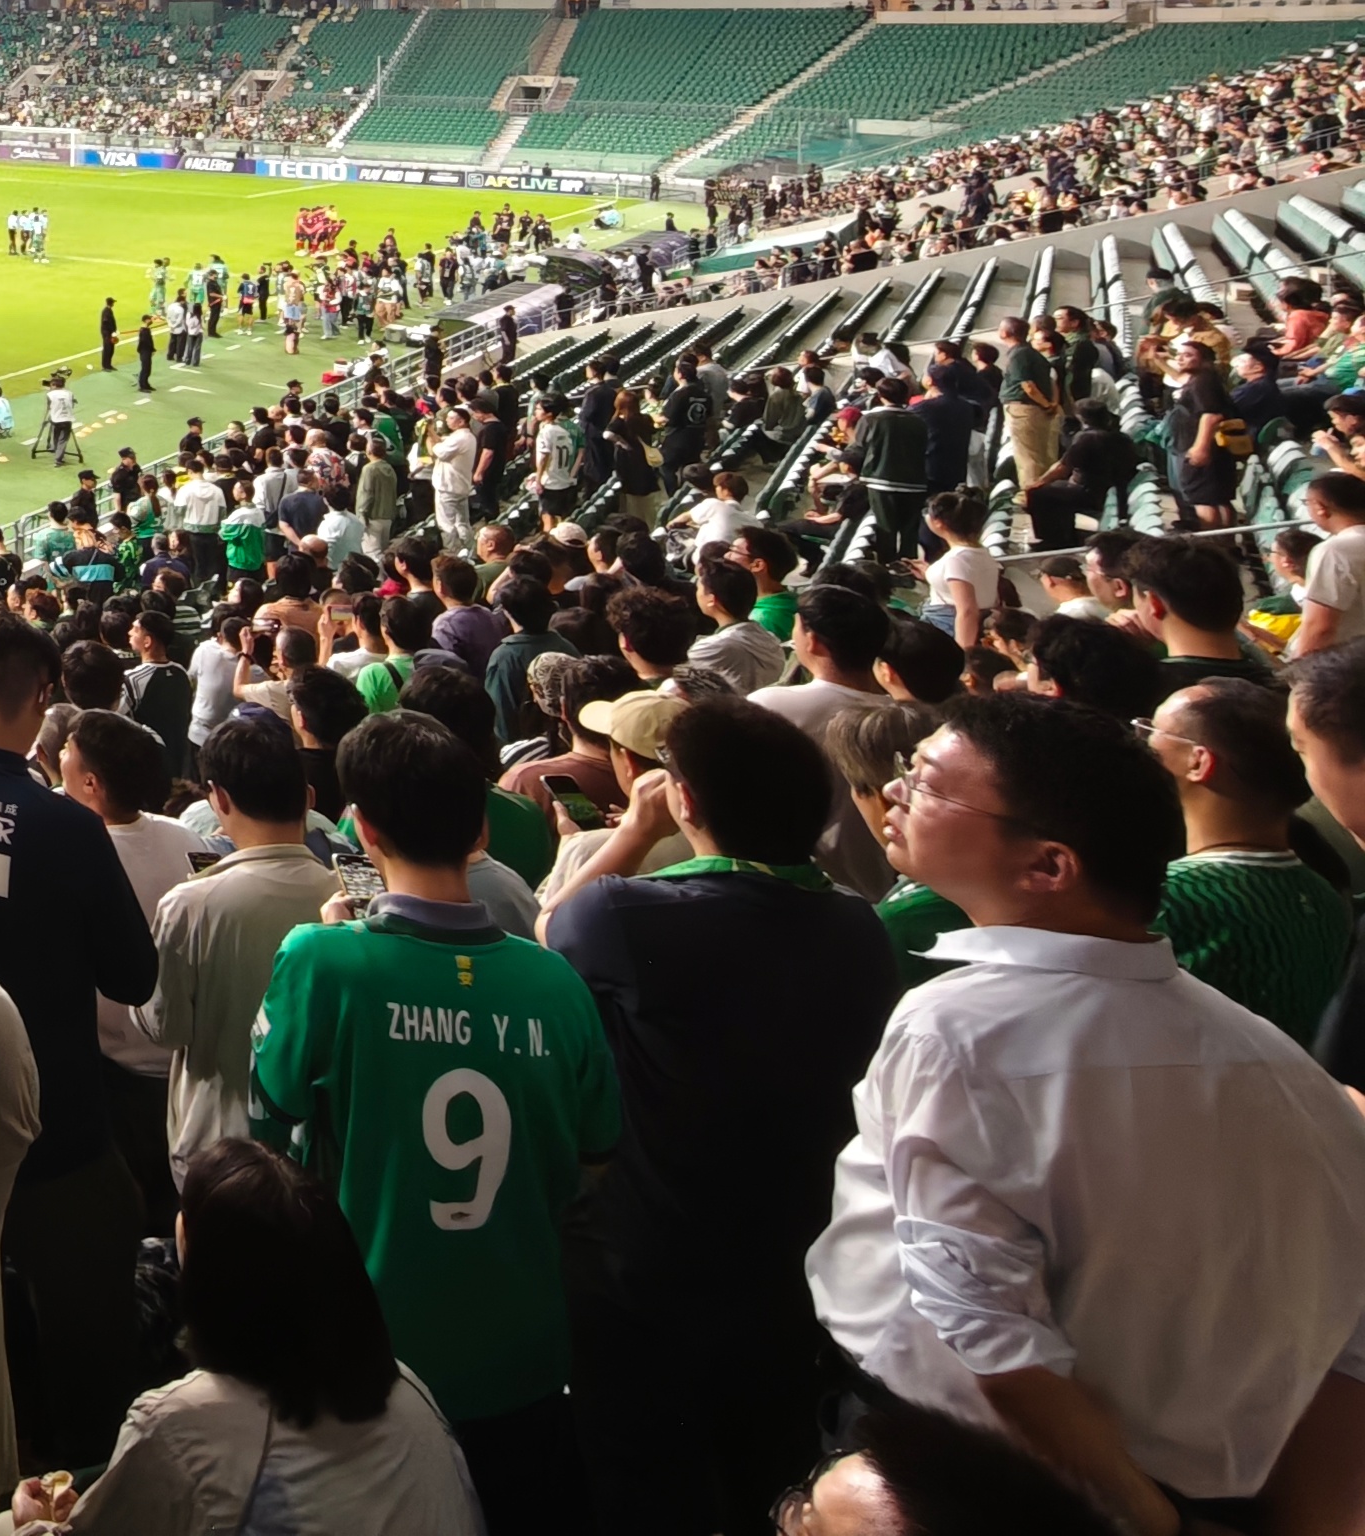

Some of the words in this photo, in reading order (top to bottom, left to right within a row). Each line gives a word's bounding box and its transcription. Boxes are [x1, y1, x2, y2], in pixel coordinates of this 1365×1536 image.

[98, 151, 137, 167] VISA
[264, 159, 347, 181] TECNO
[485, 175, 518, 189] AFC
[521, 177, 557, 192] LIVE
[556, 445, 569, 469] 11
[386, 1002, 472, 1045] ZHANG
[422, 1067, 512, 1231] 9
